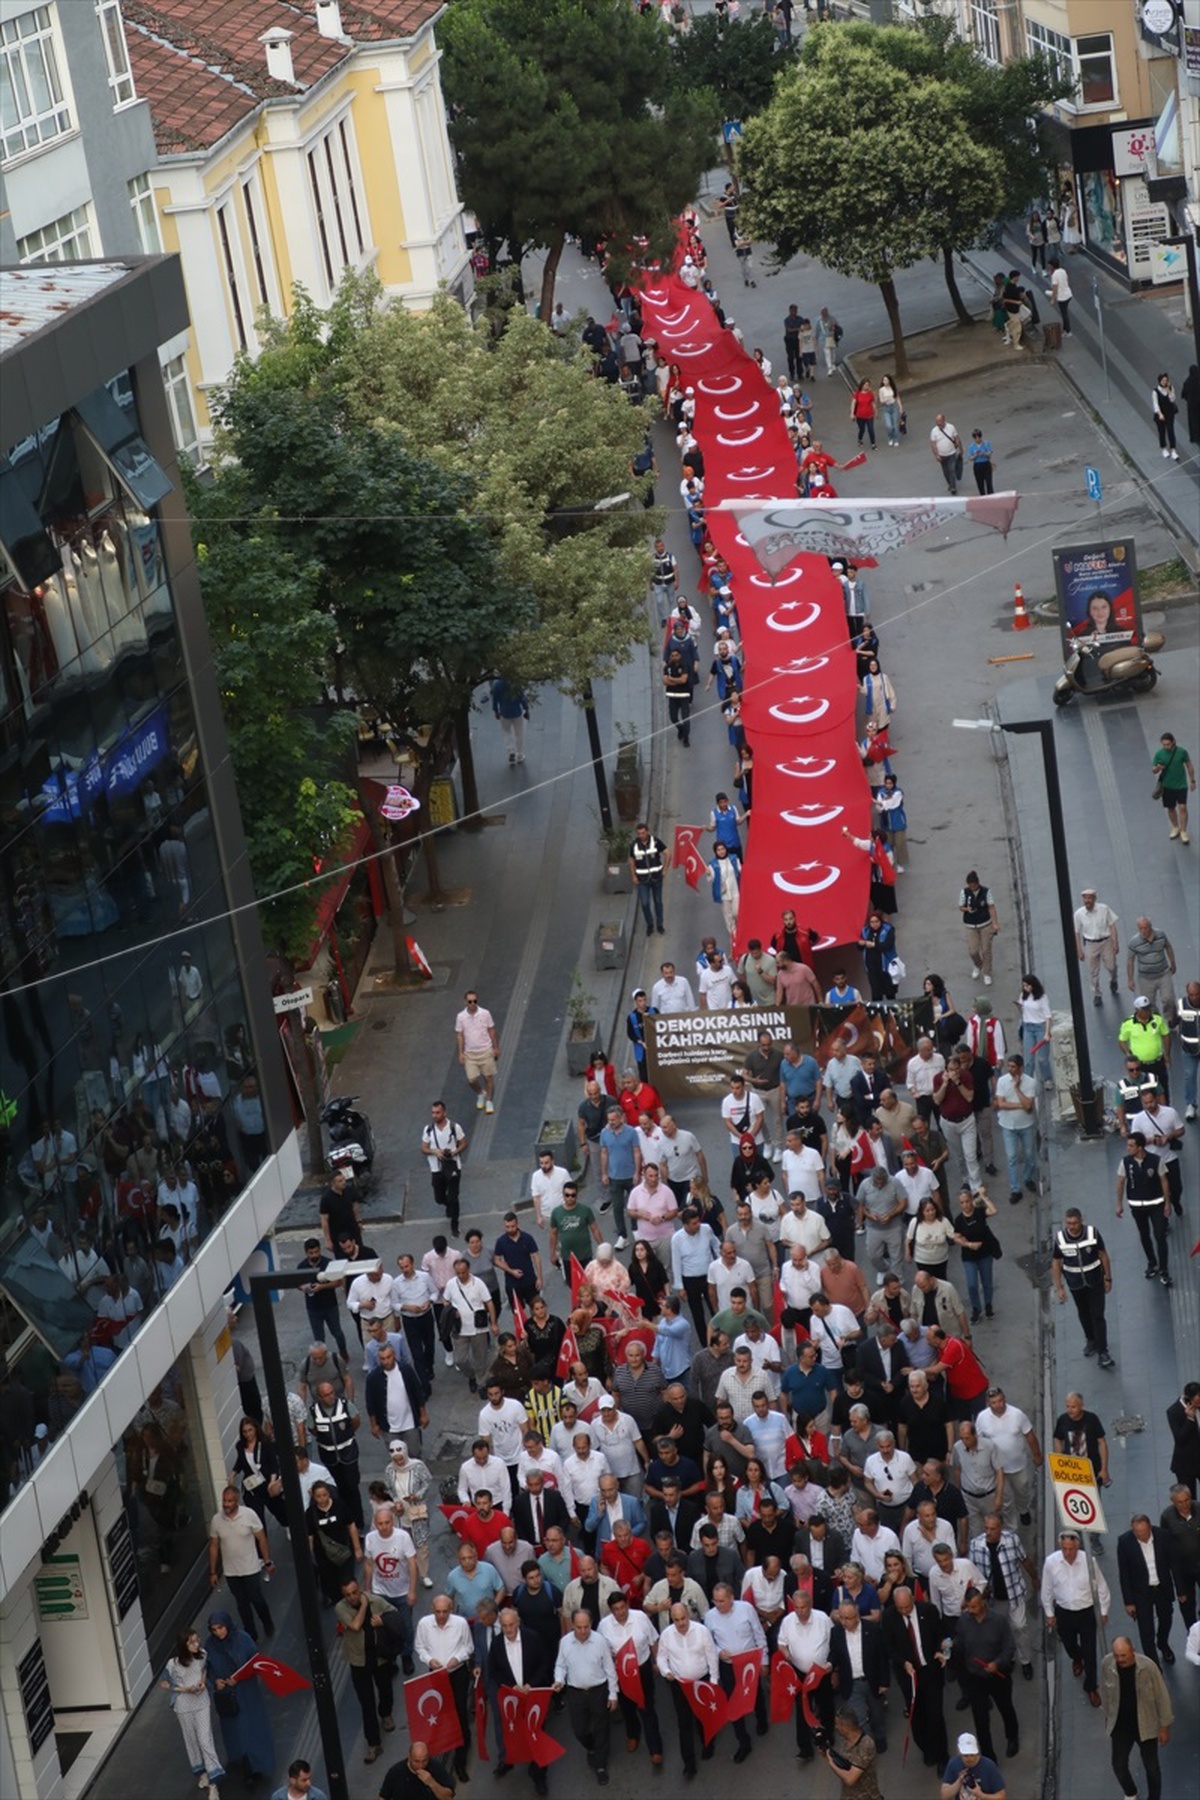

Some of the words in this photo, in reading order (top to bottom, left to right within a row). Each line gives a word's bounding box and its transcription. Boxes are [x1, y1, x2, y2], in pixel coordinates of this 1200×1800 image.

[1088, 469, 1096, 492] P
[281, 993, 310, 1006] Otopark
[1057, 1459, 1083, 1470] OKUL
[1069, 1498, 1090, 1515] 30
